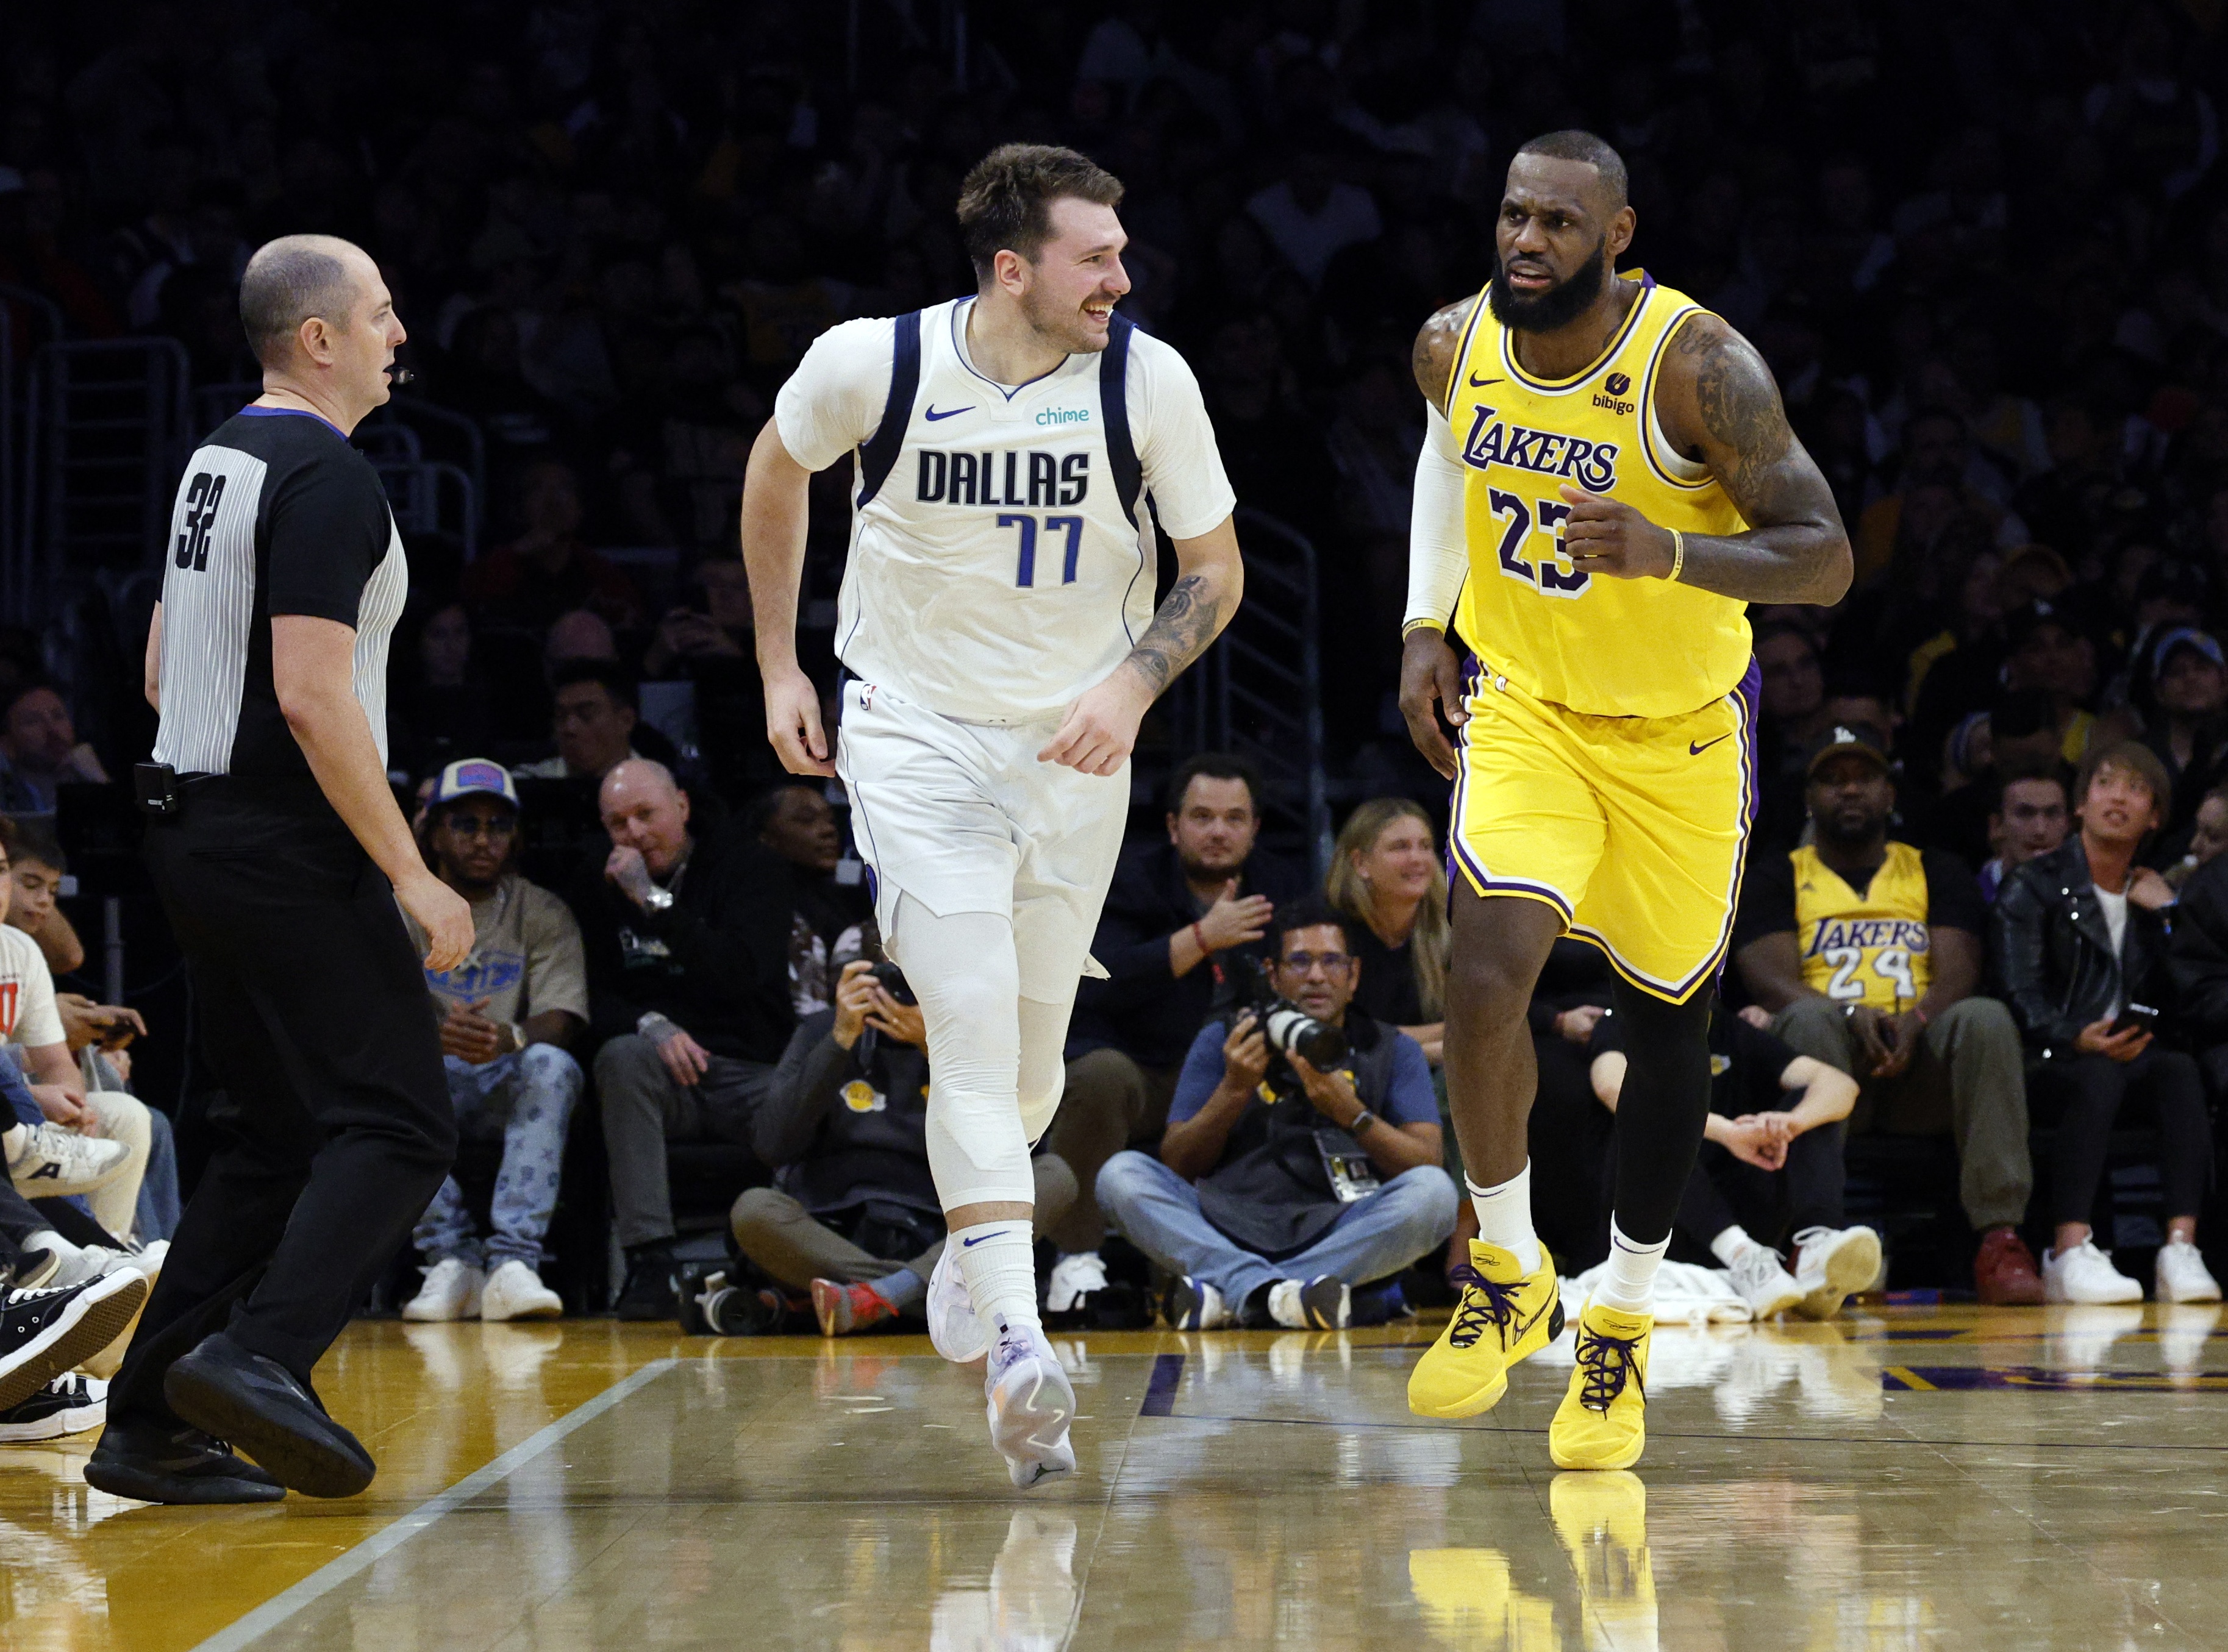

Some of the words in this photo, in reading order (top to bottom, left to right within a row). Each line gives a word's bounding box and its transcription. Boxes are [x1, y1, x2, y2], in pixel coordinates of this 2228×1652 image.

[1035, 407, 1090, 425] chime
[1592, 394, 1635, 416] bibigo
[916, 448, 1091, 508] DALLAS
[1462, 402, 1620, 494] LAKERS
[175, 472, 226, 572] 32
[996, 513, 1084, 588] 77
[1486, 485, 1593, 600] 23
[1803, 916, 1930, 958] LAKERS
[1824, 946, 1916, 999] 24
